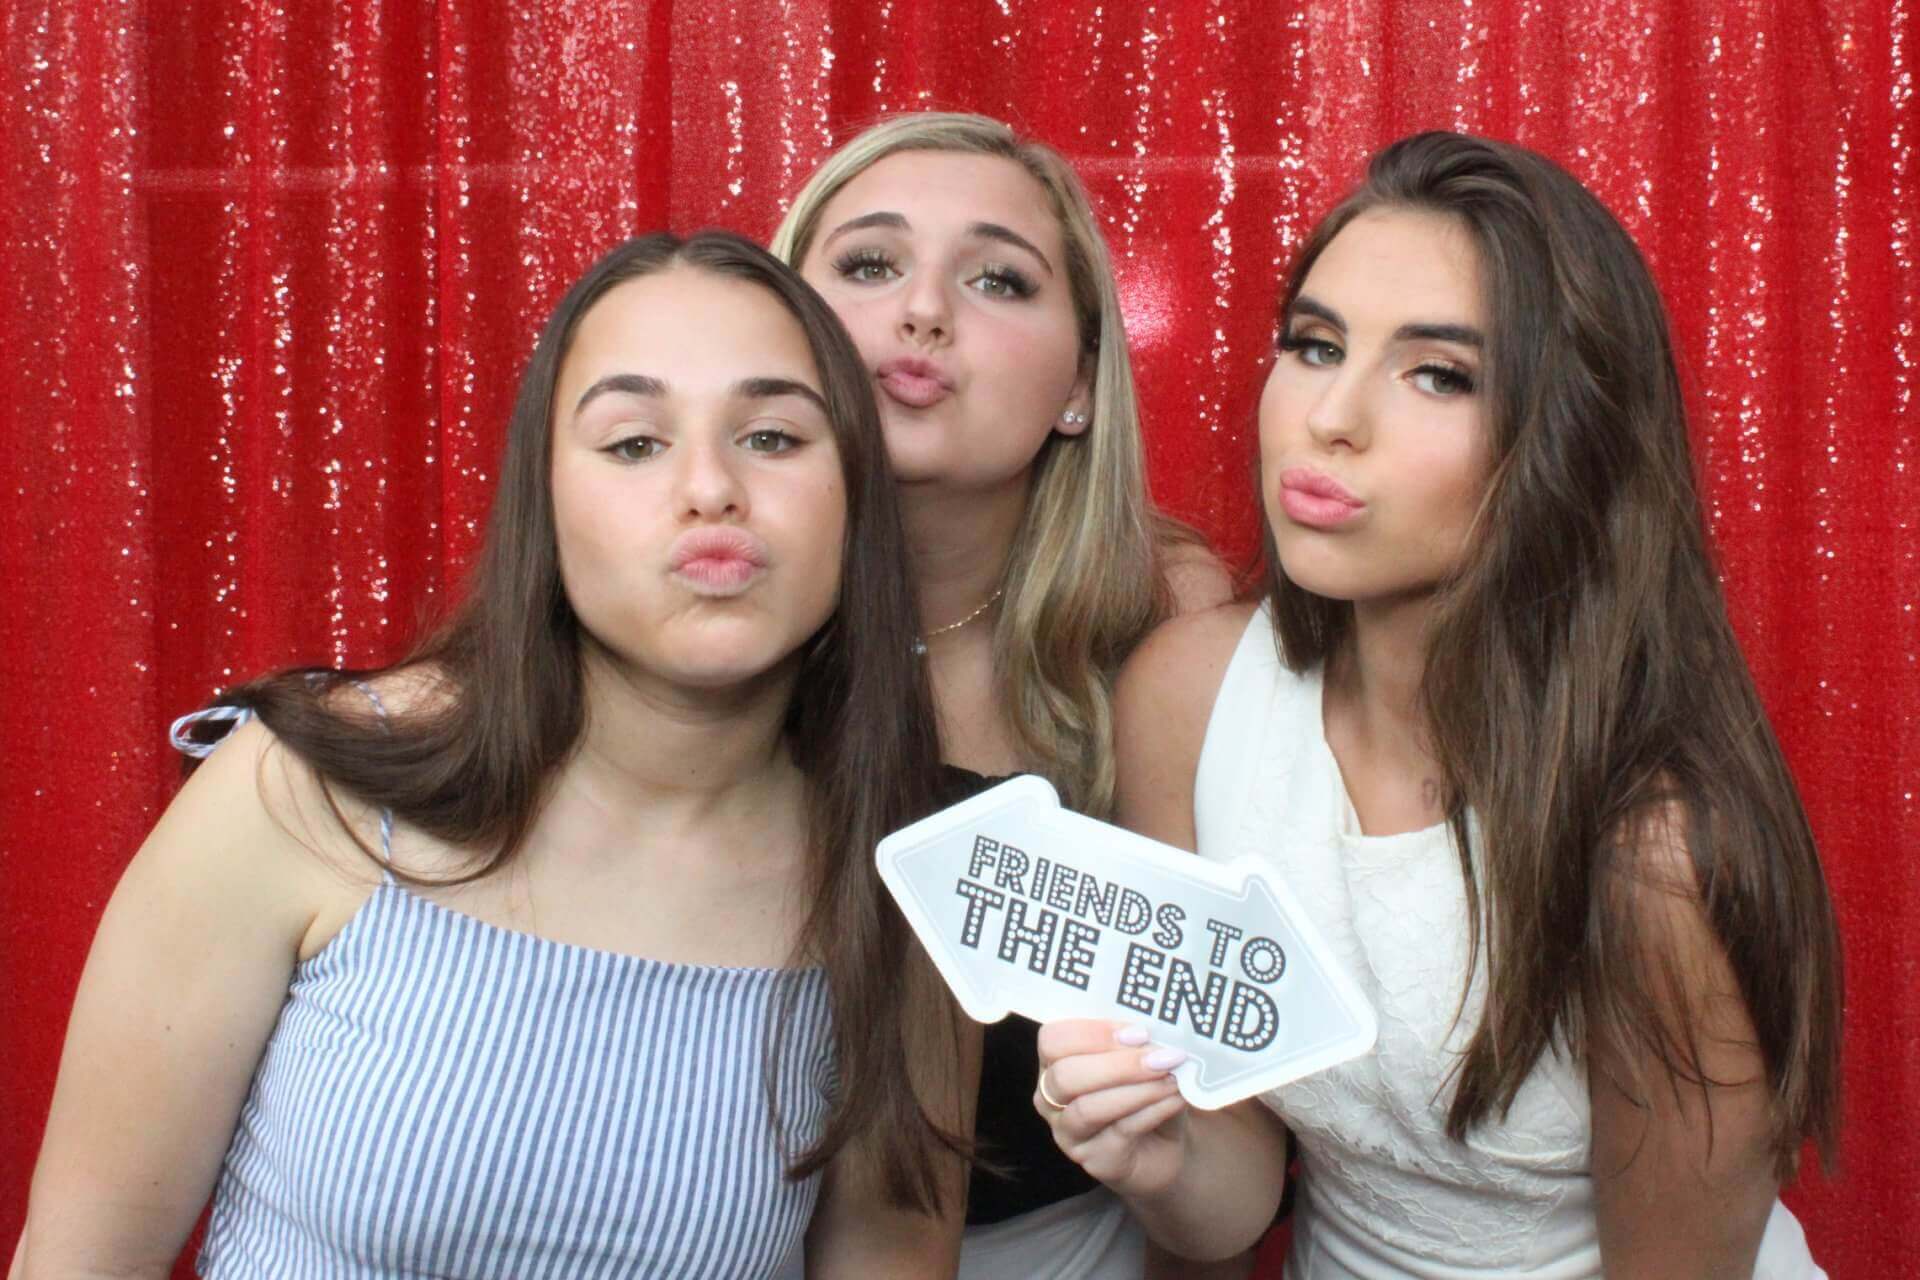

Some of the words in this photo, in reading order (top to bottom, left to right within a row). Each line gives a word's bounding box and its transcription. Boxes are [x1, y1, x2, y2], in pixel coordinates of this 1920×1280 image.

[956, 879, 1101, 991] THE
[1117, 942, 1280, 1052] END
[969, 835, 1187, 949] FRIENDS
[1206, 919, 1286, 984] TO
